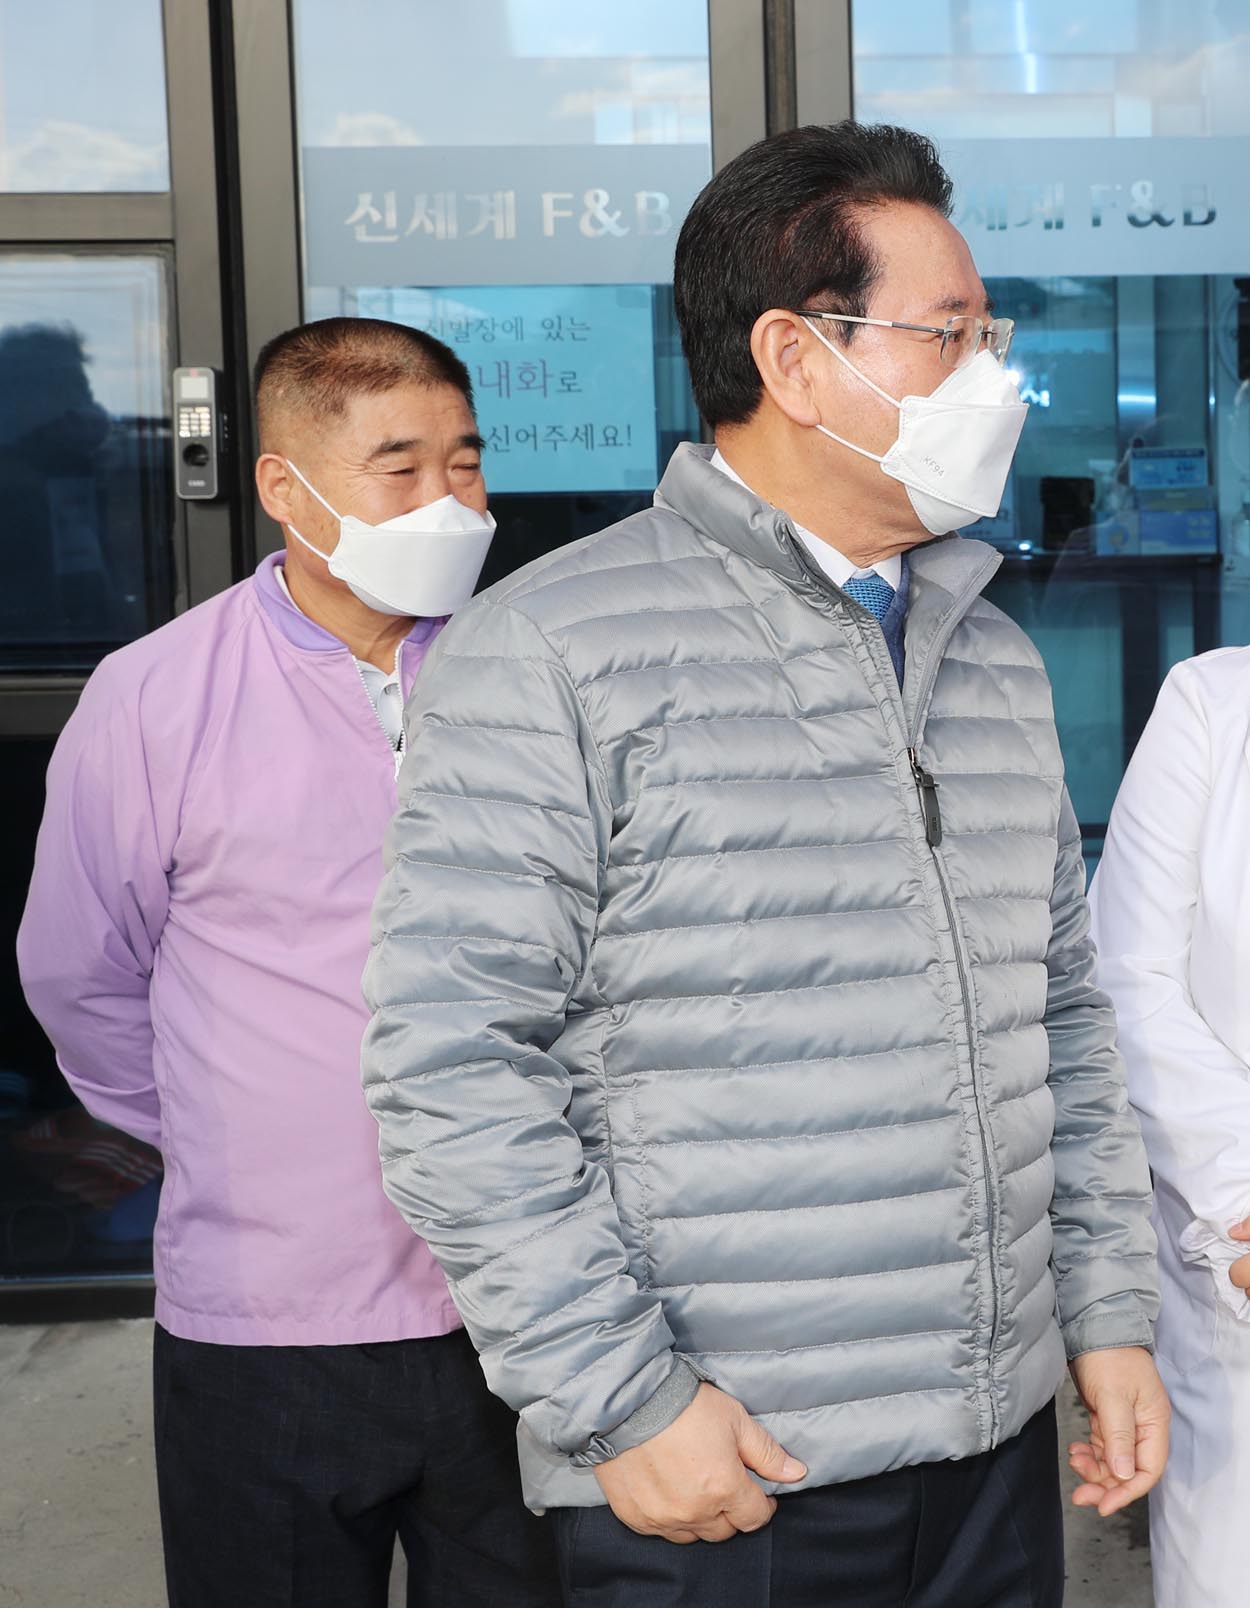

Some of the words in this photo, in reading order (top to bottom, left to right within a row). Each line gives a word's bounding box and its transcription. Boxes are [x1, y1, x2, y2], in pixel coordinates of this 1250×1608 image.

[344, 189, 518, 244] 신세계
[541, 187, 673, 240] F&B
[959, 181, 1065, 231] 세계
[1089, 179, 1217, 229] F&B
[540, 315, 591, 342] 있는
[477, 359, 583, 399] 내화로
[487, 424, 632, 452] 신어주세요!
